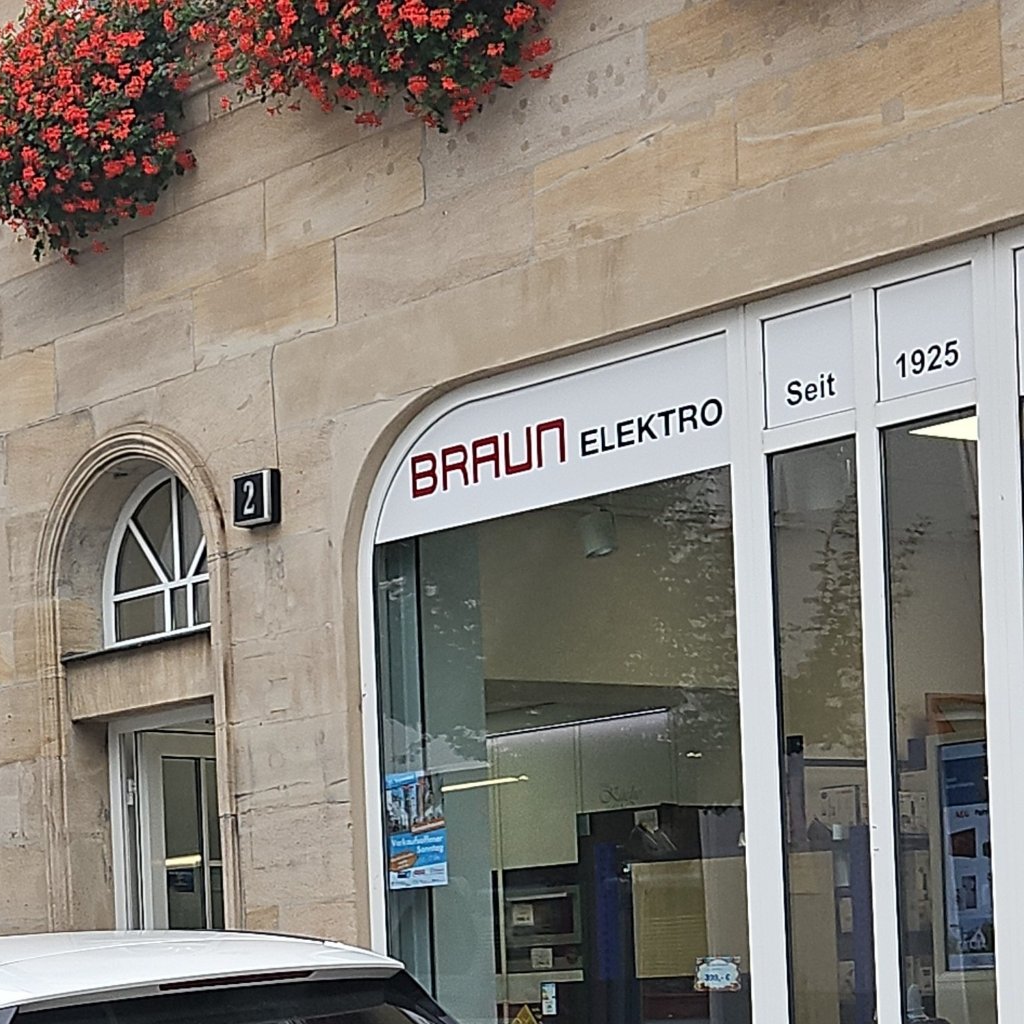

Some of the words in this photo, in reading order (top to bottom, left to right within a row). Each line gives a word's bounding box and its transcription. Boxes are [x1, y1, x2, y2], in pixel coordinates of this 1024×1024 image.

[787, 373, 836, 406] Seit
[895, 340, 959, 378] 1925
[411, 418, 567, 499] BRAUN
[580, 399, 724, 457] ELEKTRO
[243, 480, 255, 515] 2
